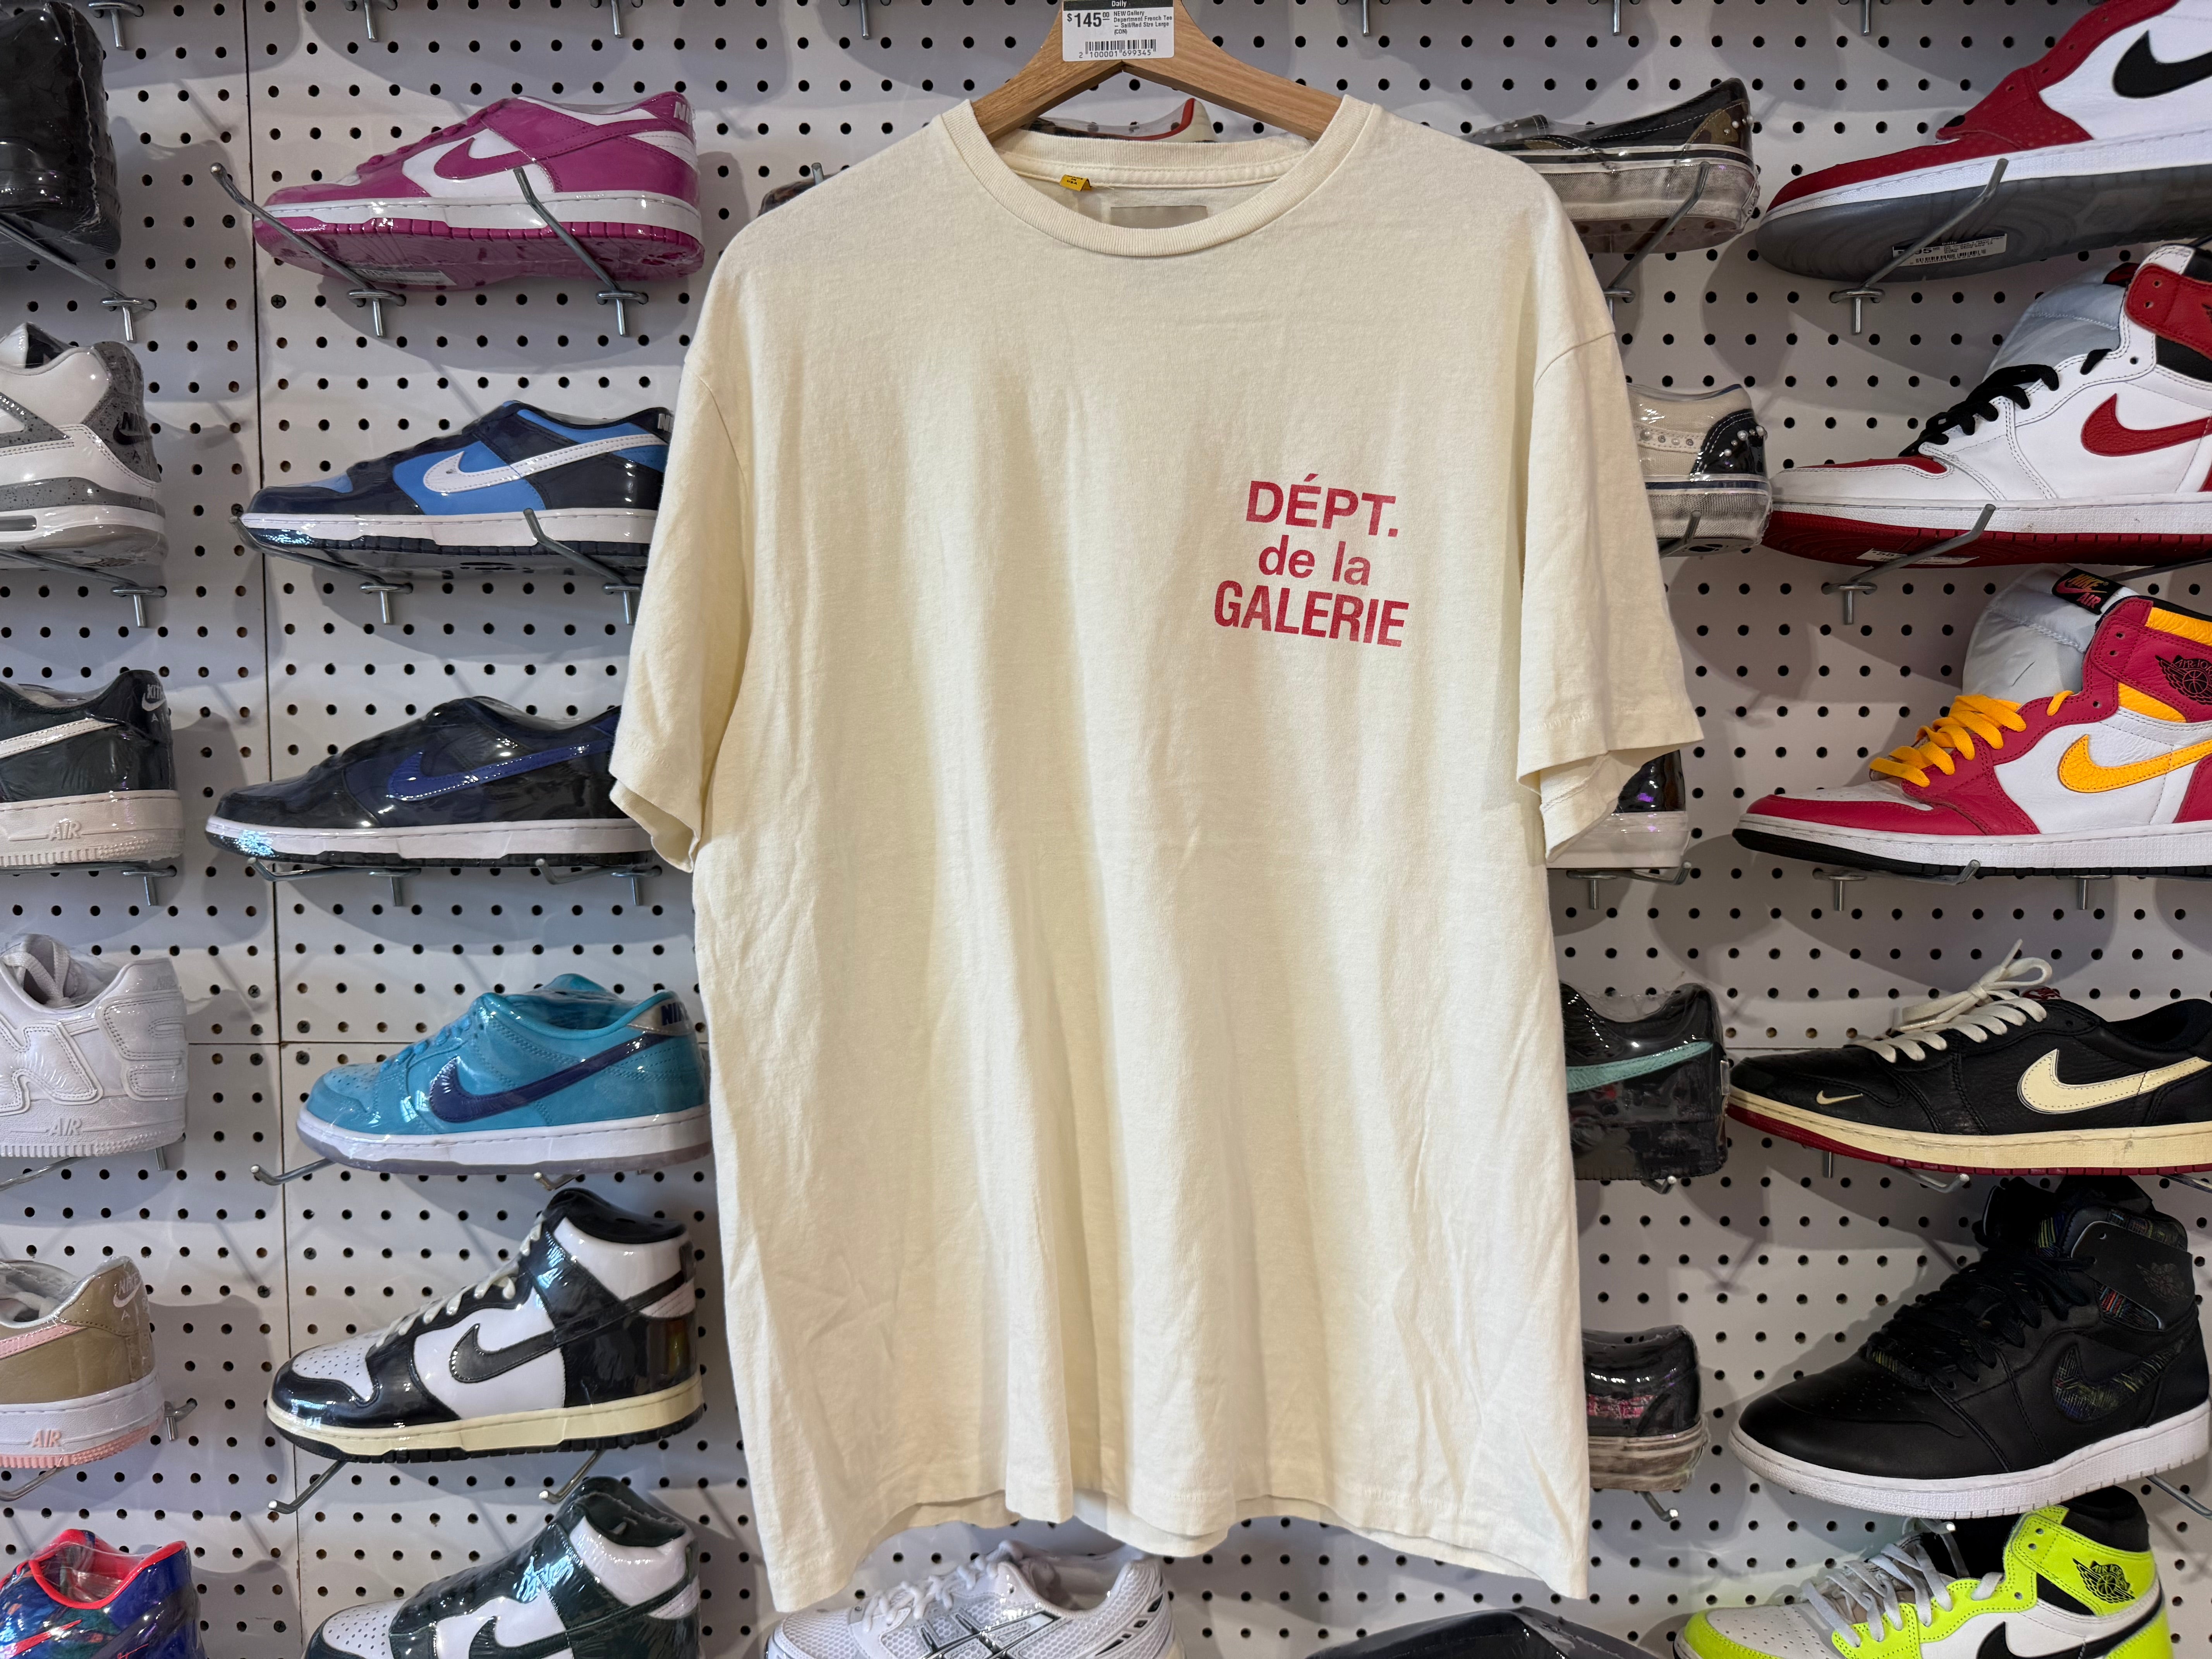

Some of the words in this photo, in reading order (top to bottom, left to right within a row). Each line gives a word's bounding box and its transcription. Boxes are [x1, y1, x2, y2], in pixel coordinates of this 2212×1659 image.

[1246, 473, 1398, 537] DÉPT.
[1259, 535, 1315, 578] de
[1332, 541, 1371, 586] la
[2076, 592, 2101, 608] AIR
[1214, 580, 1409, 647] GALERIE
[48, 820, 82, 840] AIR
[48, 1116, 82, 1136] AIR
[31, 1430, 62, 1448] AIR
